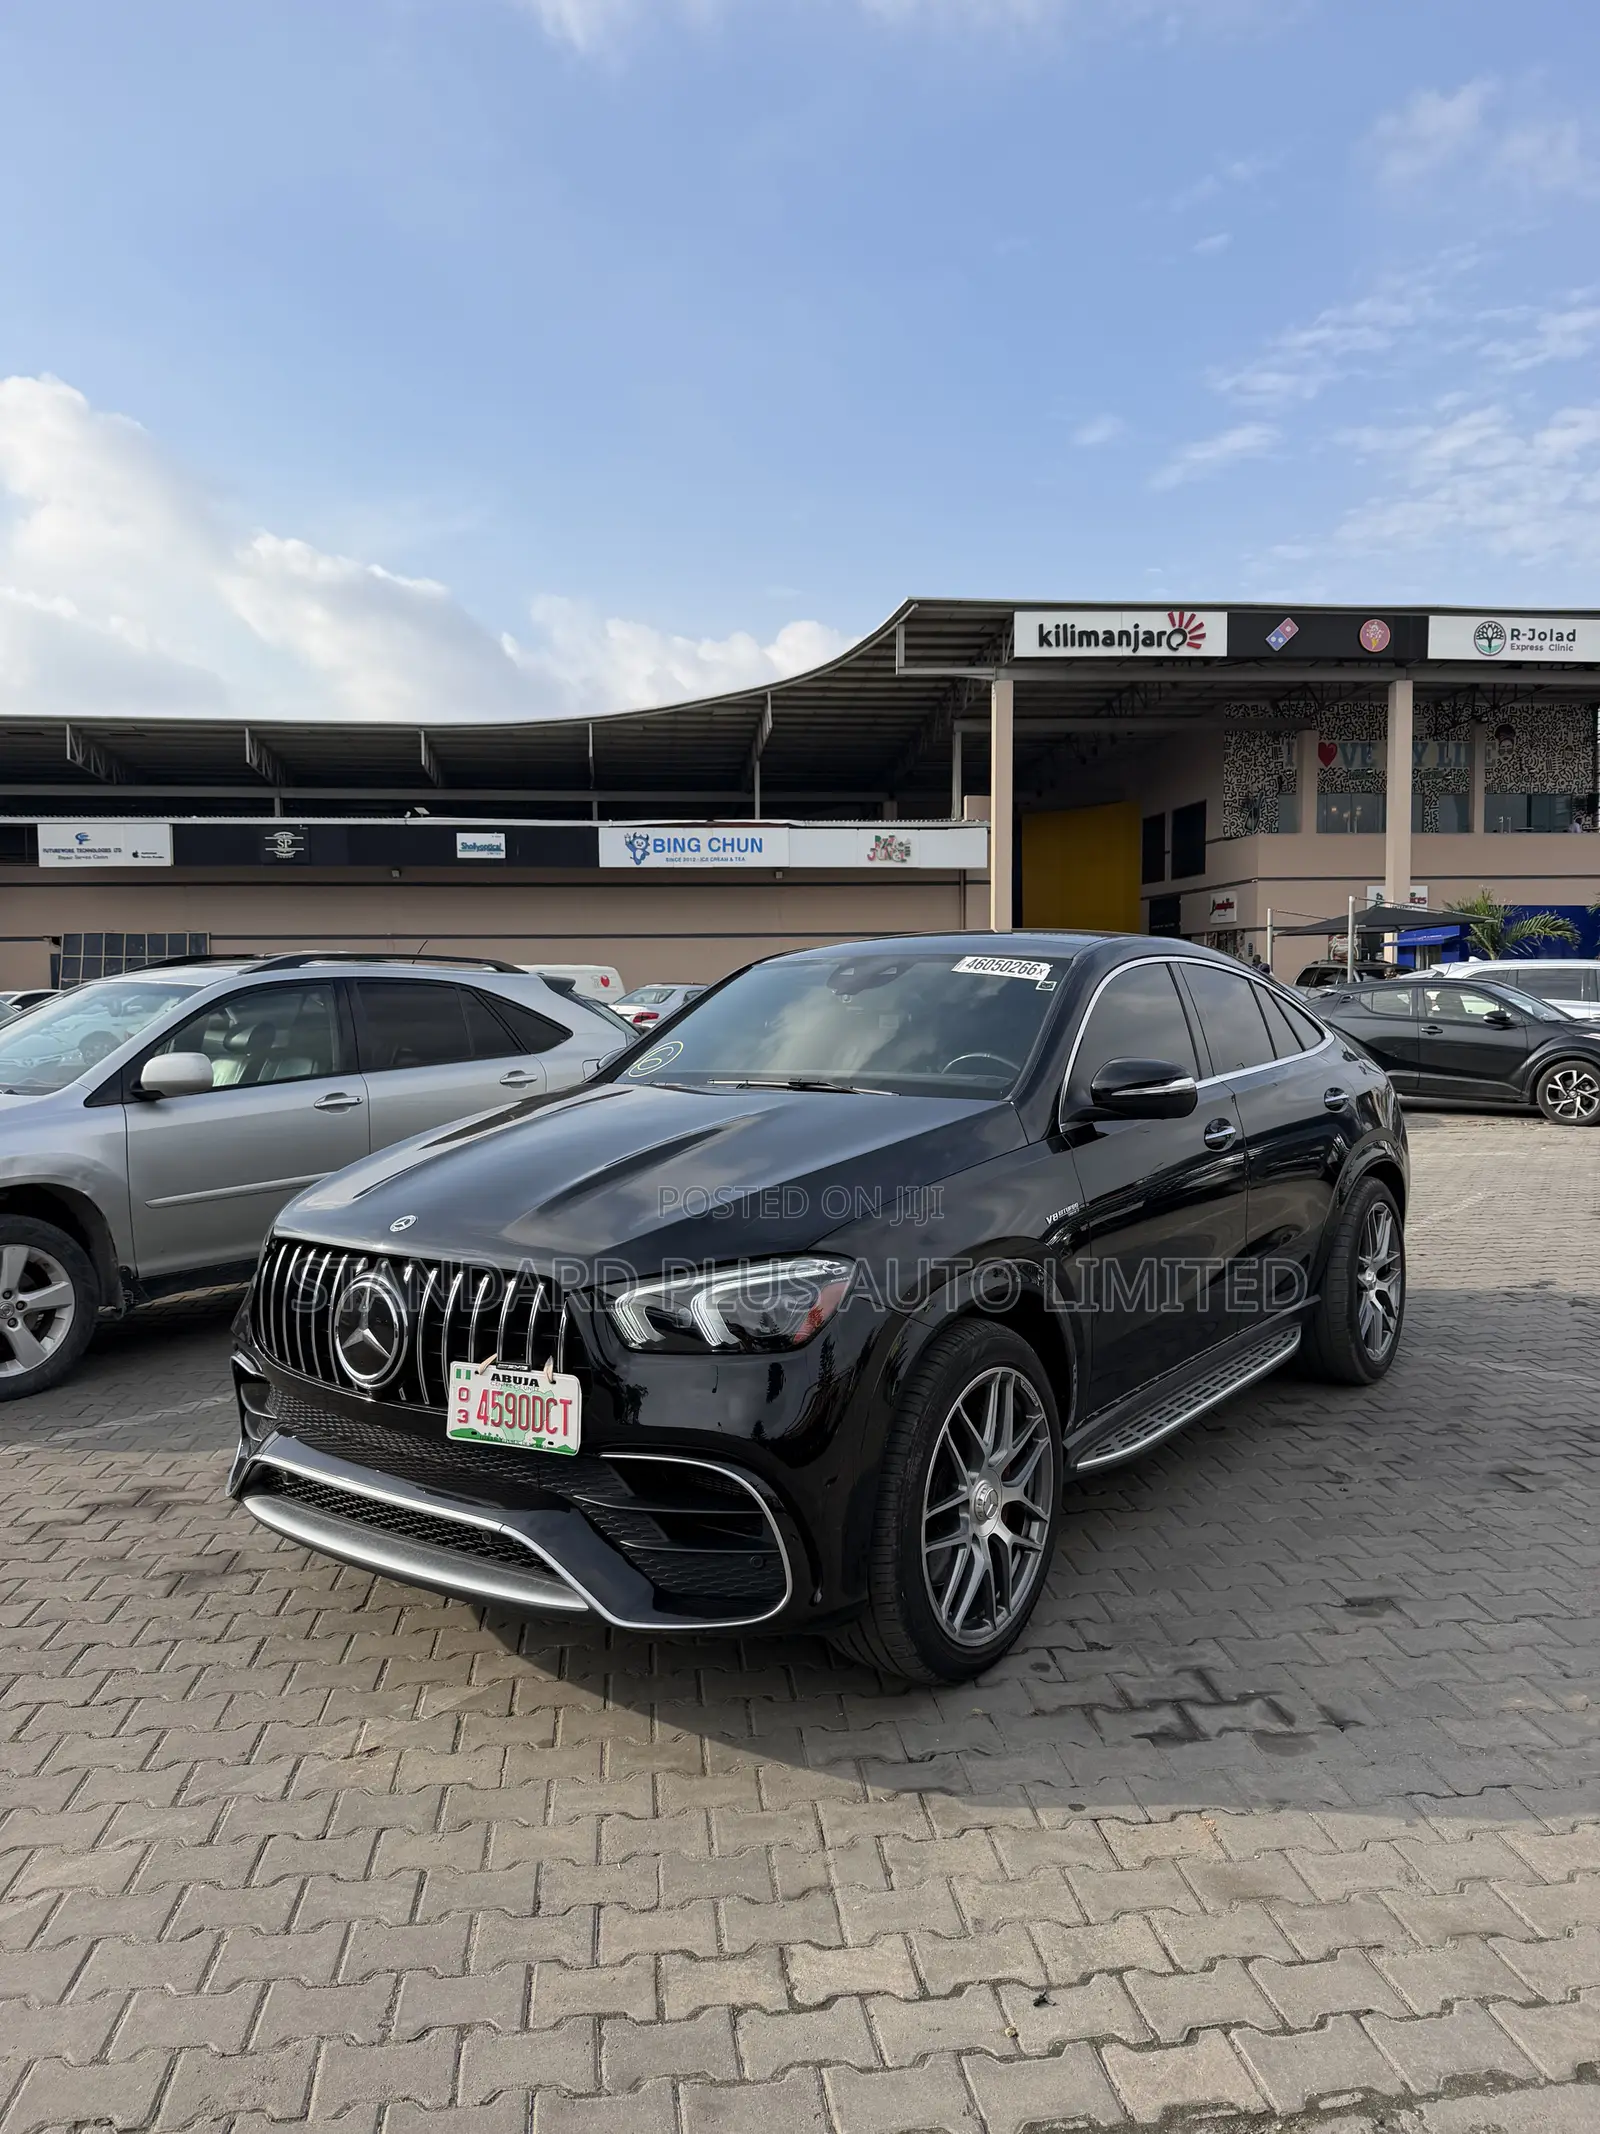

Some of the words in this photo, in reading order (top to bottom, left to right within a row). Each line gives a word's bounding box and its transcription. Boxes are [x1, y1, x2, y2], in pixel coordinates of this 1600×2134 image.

[1038, 623, 1187, 653] kilimanjaro
[1510, 628, 1577, 642] R-Jolad
[1510, 643, 1544, 652] Express
[1548, 643, 1574, 652] Clinic
[653, 837, 700, 853] BING
[708, 837, 763, 853] CHUN
[965, 958, 1040, 976] 46050266
[1045, 1212, 1059, 1225] V8
[491, 1373, 540, 1387] ABUJA
